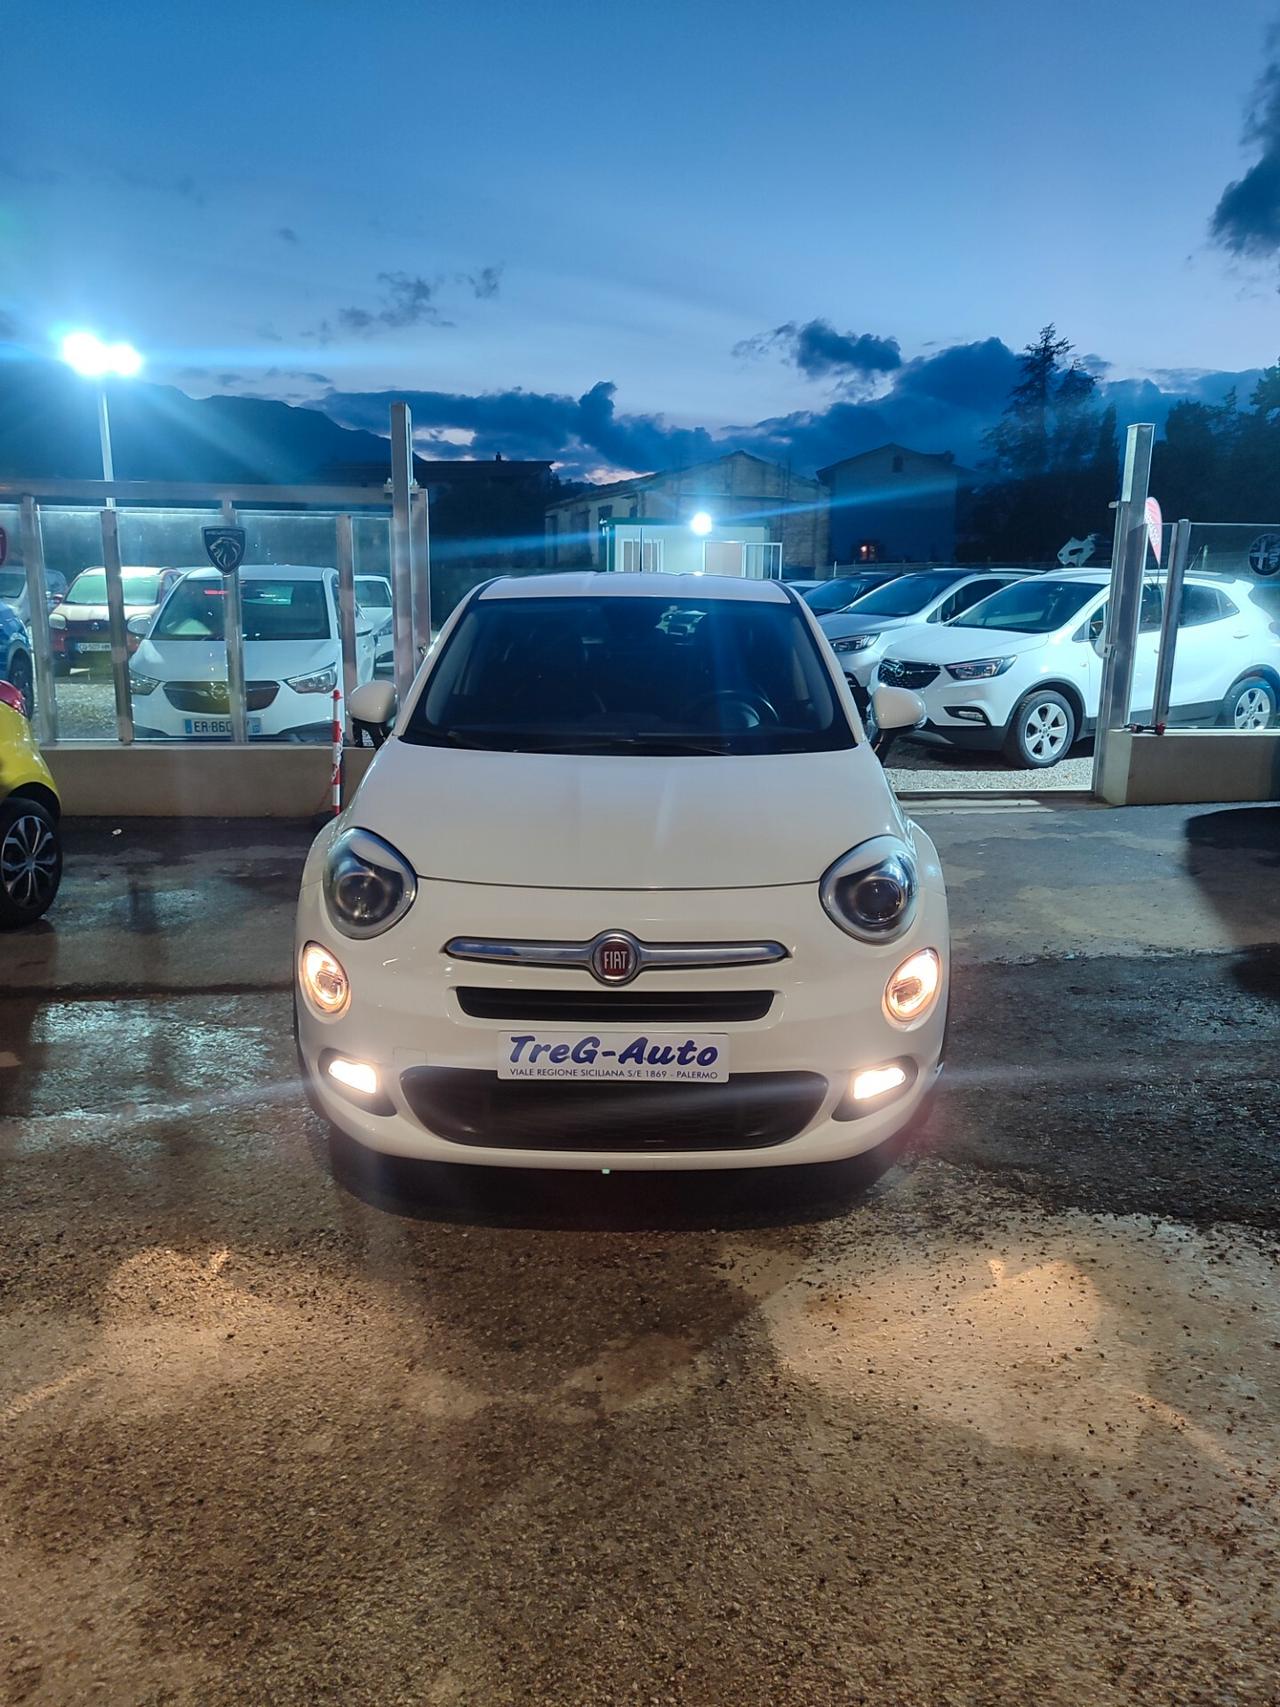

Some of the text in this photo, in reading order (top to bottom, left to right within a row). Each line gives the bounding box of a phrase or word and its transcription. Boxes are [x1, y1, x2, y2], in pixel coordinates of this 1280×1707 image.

[604, 951, 628, 969] FIAT
[510, 1035, 718, 1066] TreG-Auto
[510, 1068, 535, 1077] VIALE
[537, 1068, 578, 1077] REGIONE
[581, 1069, 625, 1077] SICILIANA
[627, 1069, 642, 1078] S/E
[645, 1070, 667, 1078] 1869
[676, 1070, 718, 1080] PALERMO
